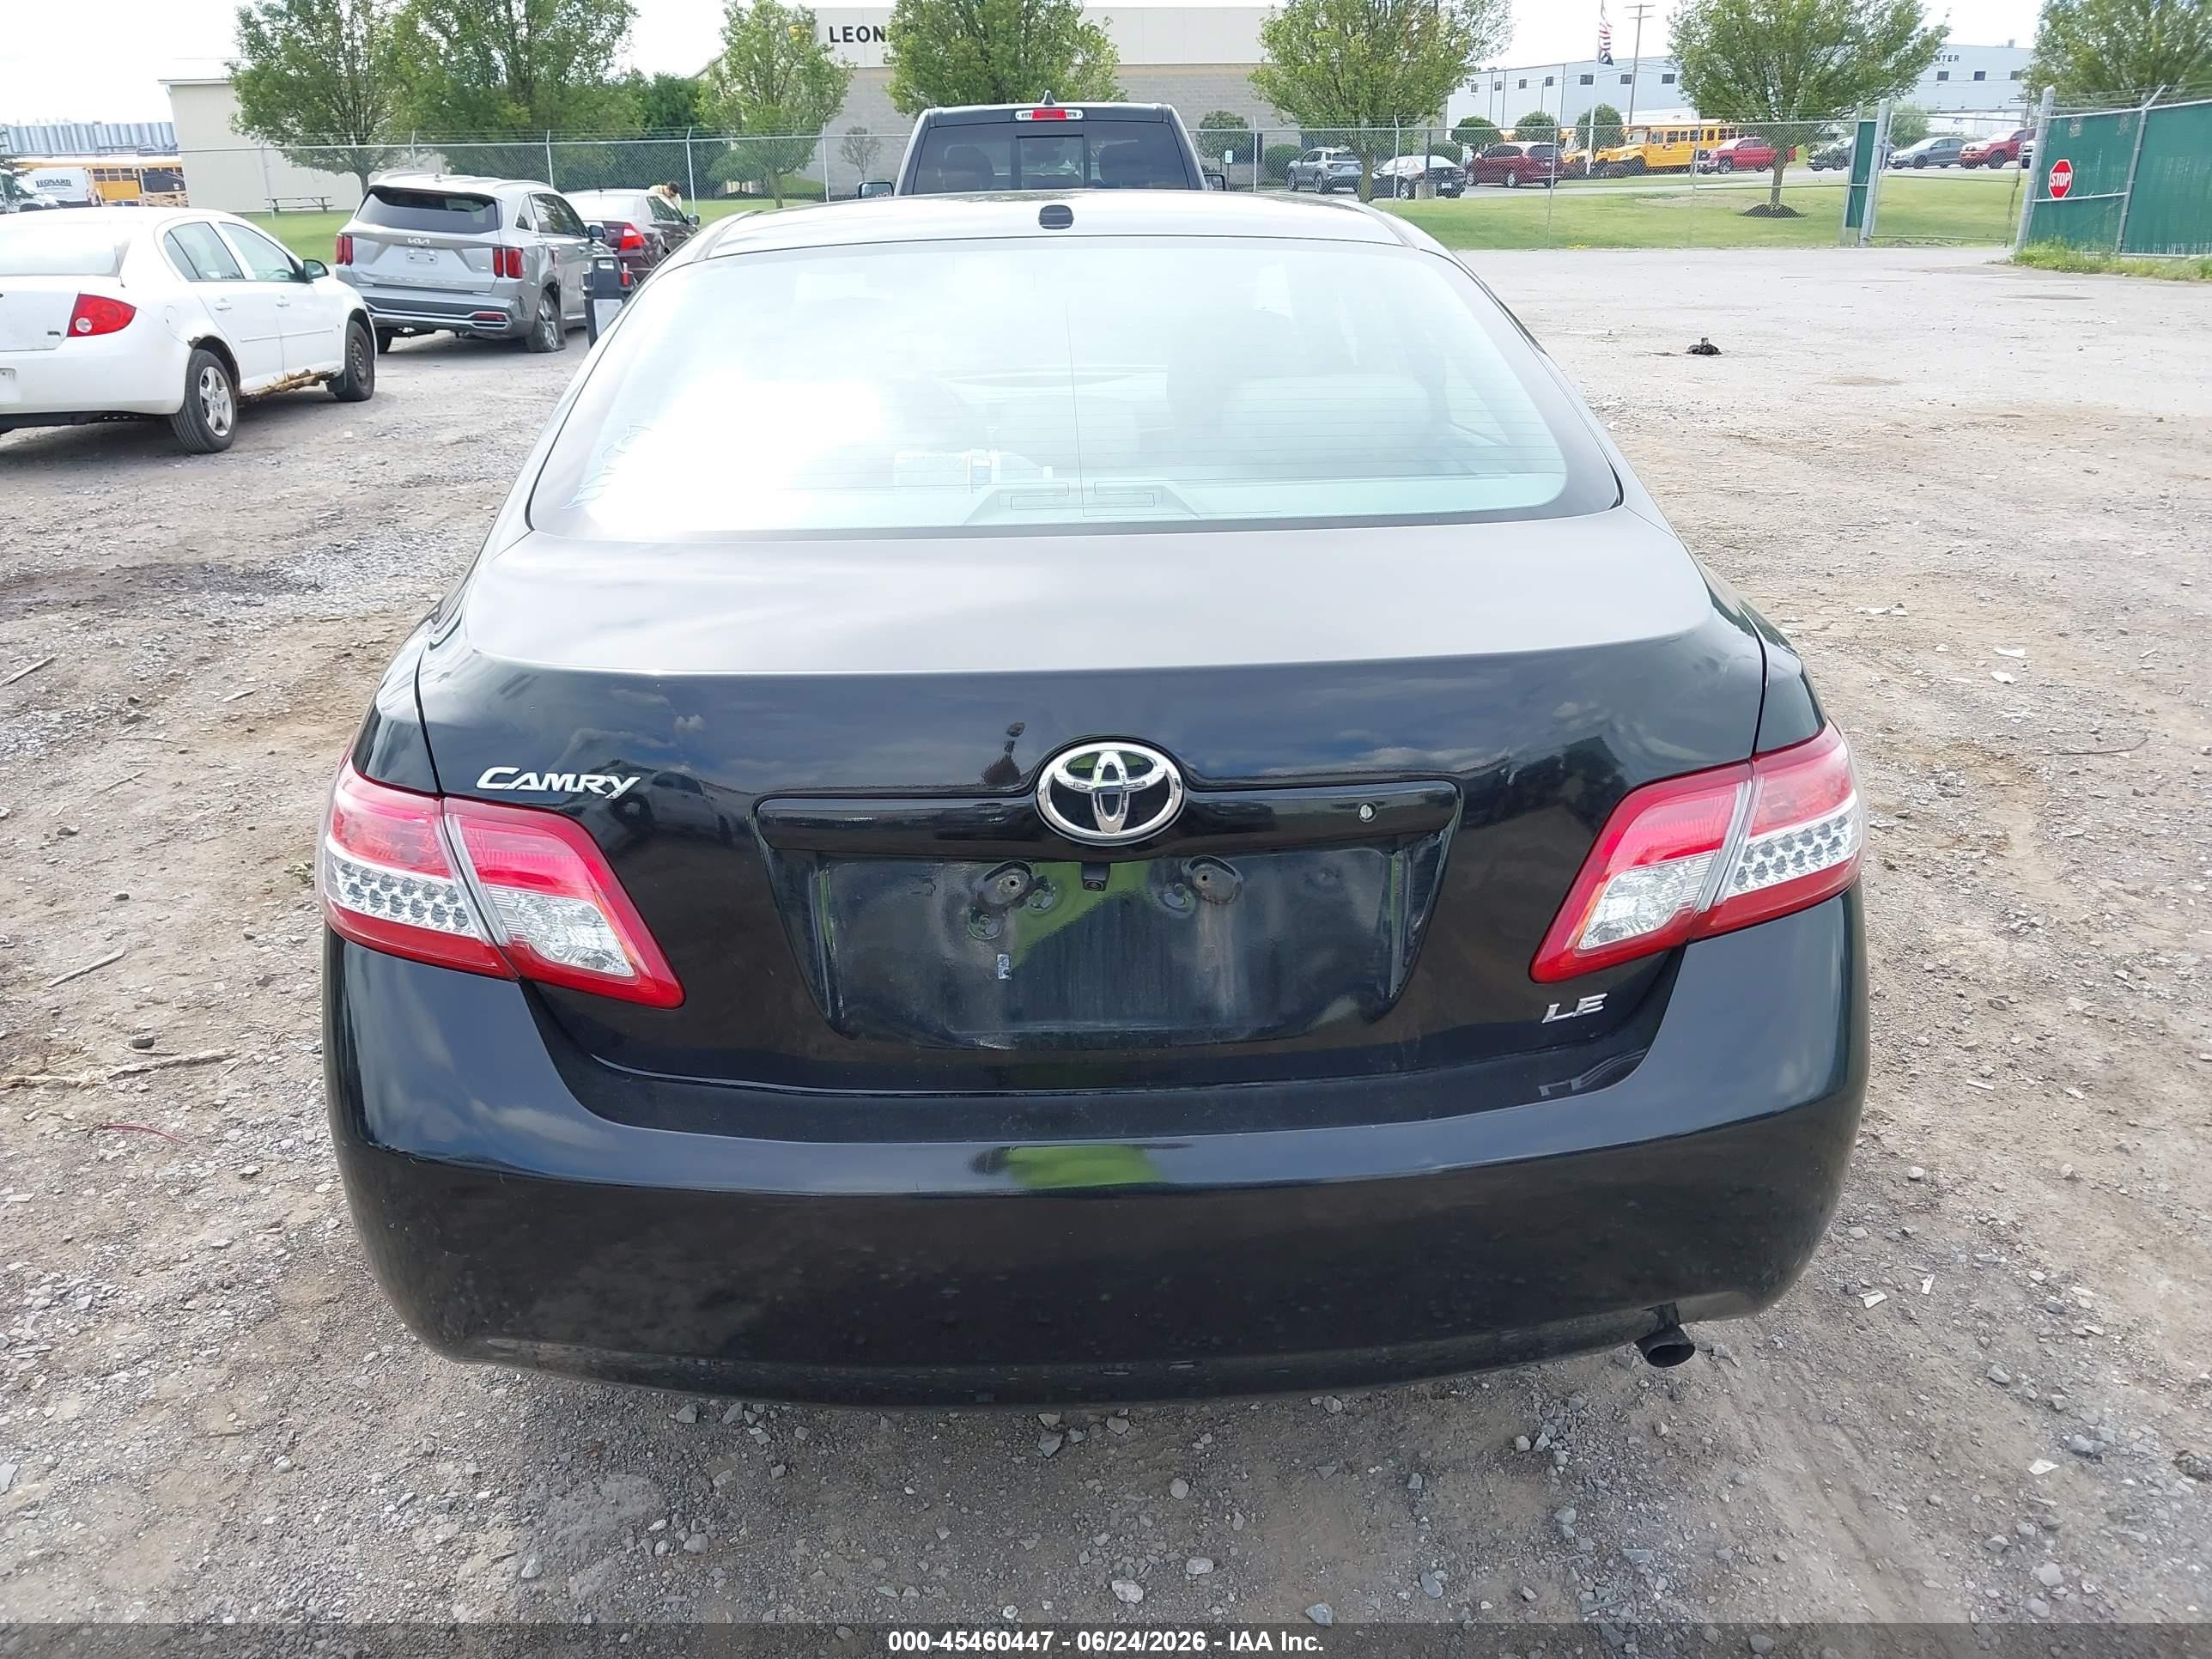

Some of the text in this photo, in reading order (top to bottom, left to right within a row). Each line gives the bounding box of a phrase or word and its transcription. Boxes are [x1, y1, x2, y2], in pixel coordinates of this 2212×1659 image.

[829, 25, 888, 43] LEON
[1932, 54, 1960, 63] NTER
[35, 178, 73, 188] LEONARD
[2051, 172, 2071, 187] STOP
[476, 766, 641, 799] CAMRY
[1541, 993, 1608, 1024] LE
